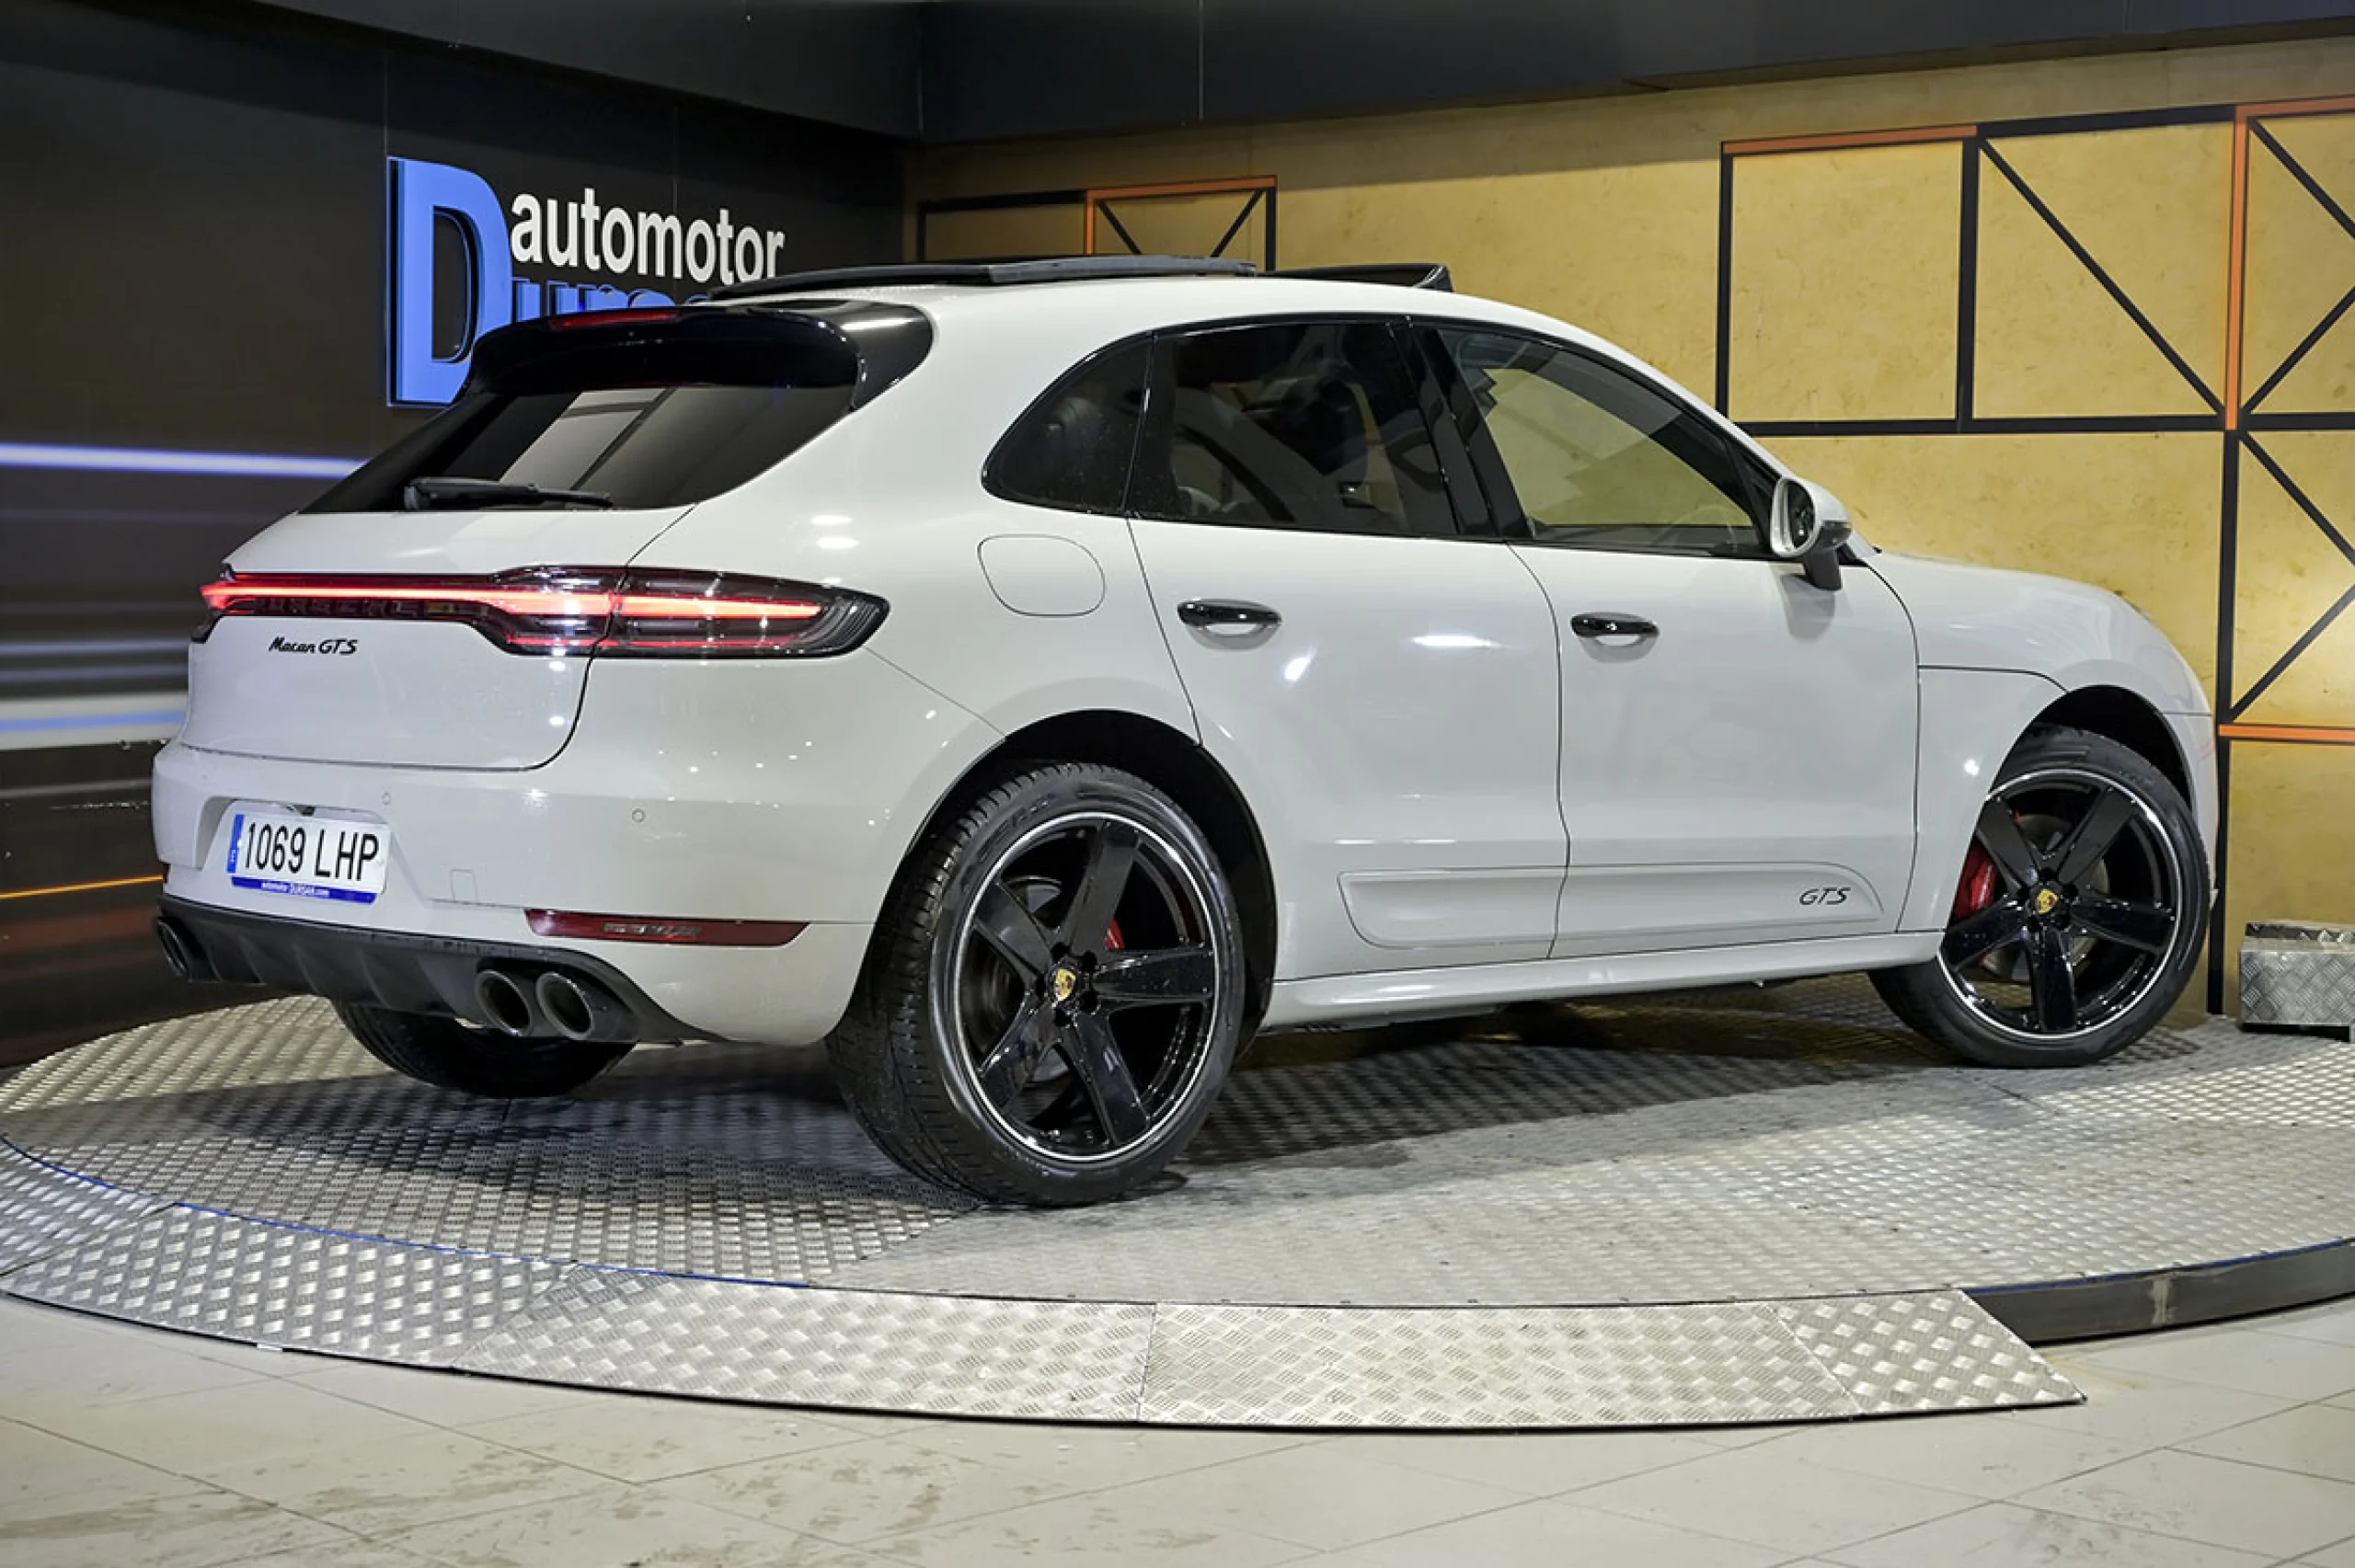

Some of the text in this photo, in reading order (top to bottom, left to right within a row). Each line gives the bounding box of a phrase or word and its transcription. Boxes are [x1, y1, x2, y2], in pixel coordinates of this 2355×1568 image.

[511, 188, 786, 285] automotor
[269, 636, 358, 655] Macan GTS
[246, 821, 379, 881] 1069 LHP
[1799, 887, 1851, 905] GTS
